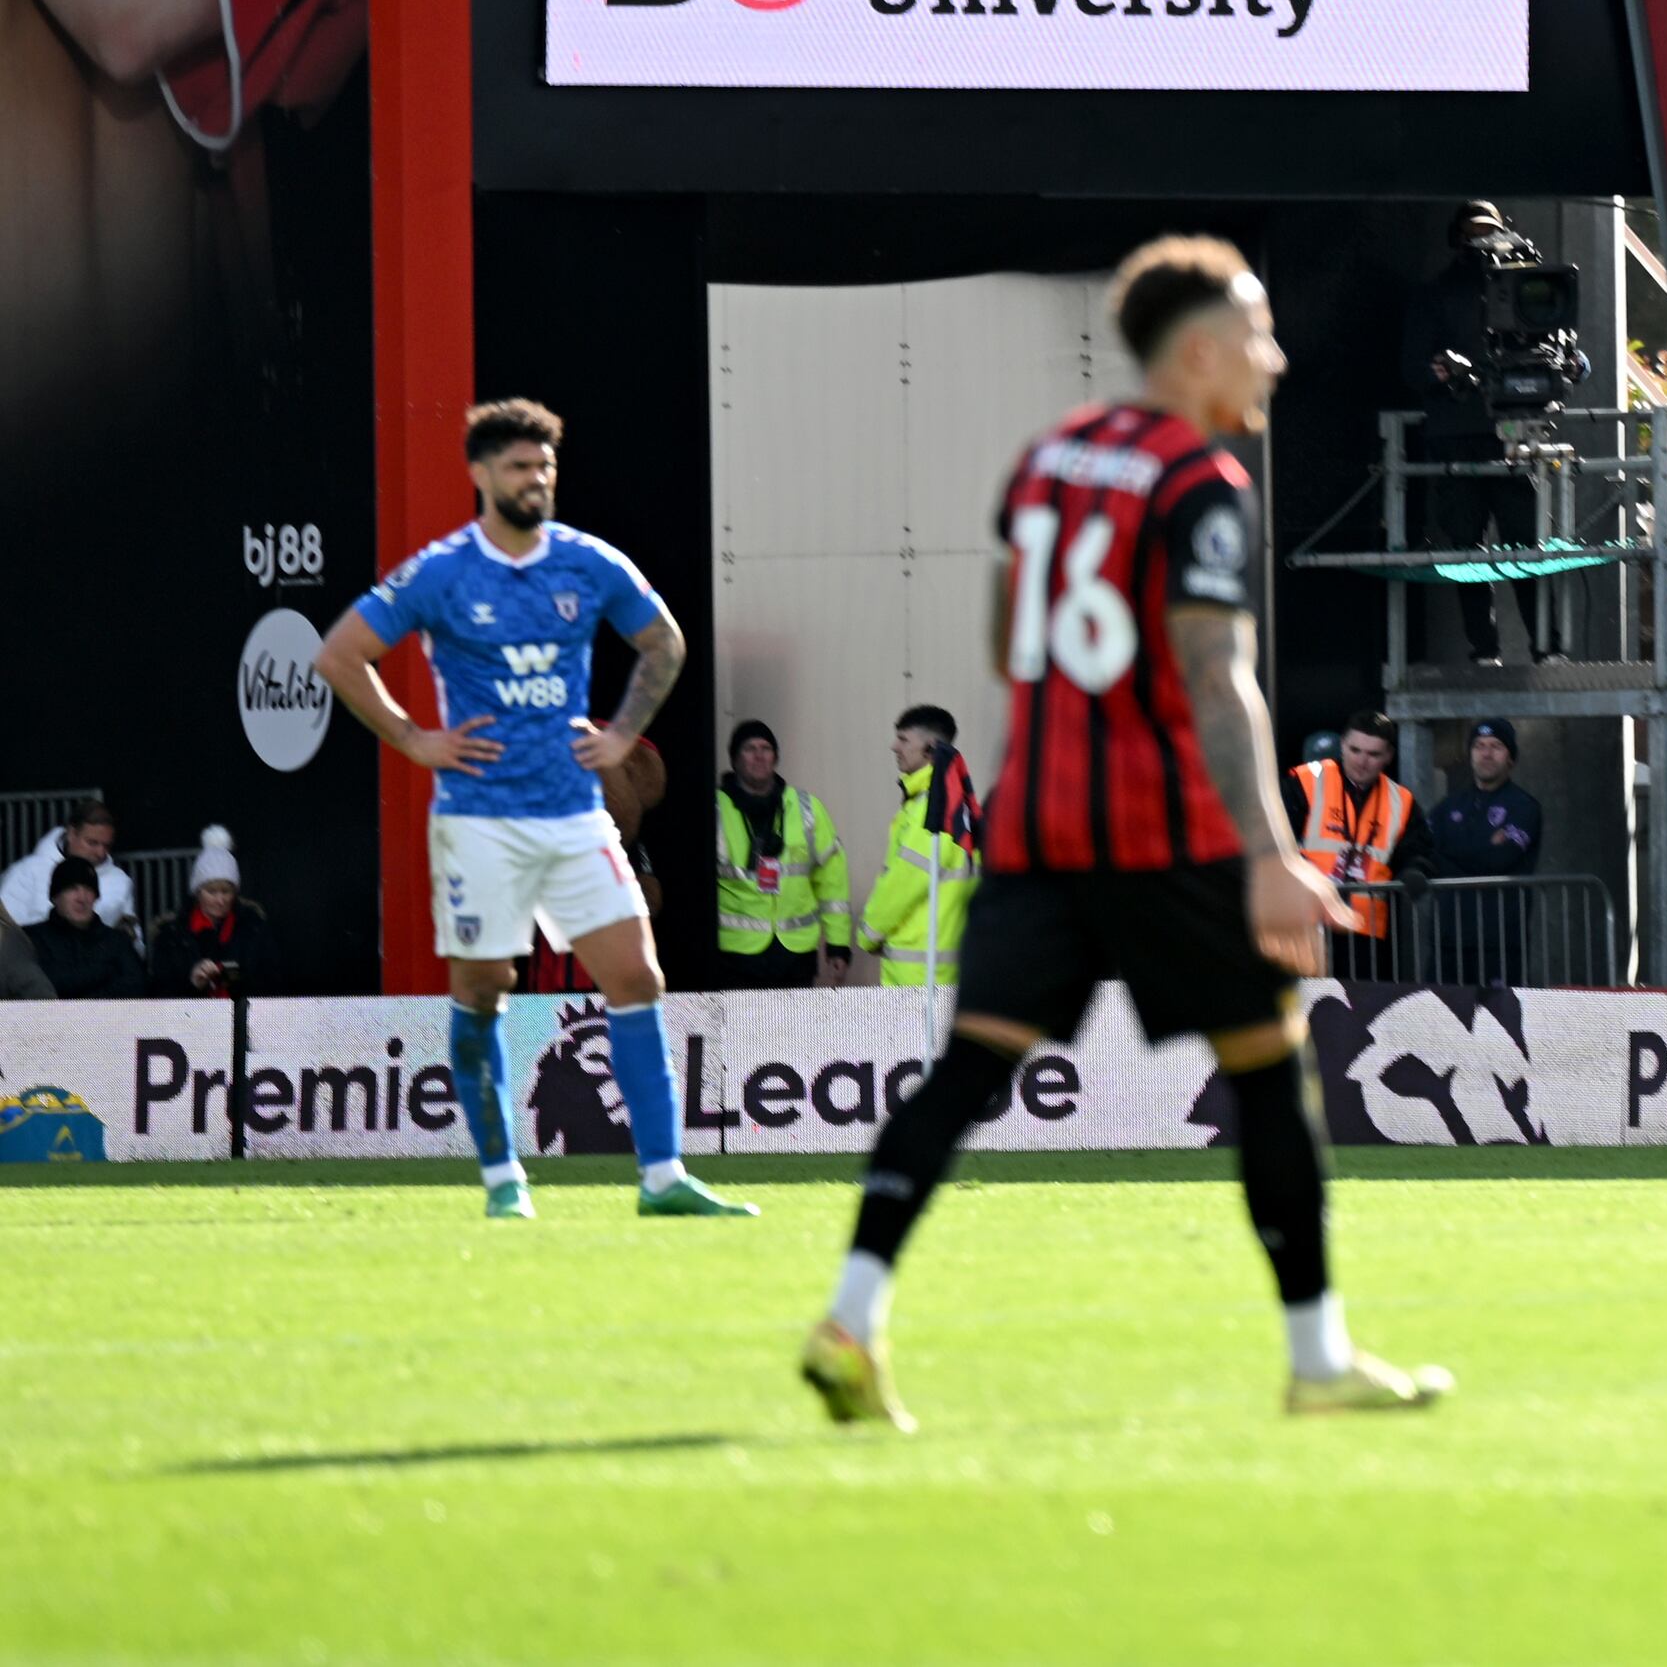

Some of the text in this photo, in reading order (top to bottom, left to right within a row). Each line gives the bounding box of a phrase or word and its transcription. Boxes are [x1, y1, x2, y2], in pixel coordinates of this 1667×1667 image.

[242, 522, 325, 589] bj88
[1007, 503, 1138, 697] 16
[243, 648, 329, 730] Vitality
[493, 675, 568, 708] W88
[135, 1035, 1081, 1134] Premie Leae
